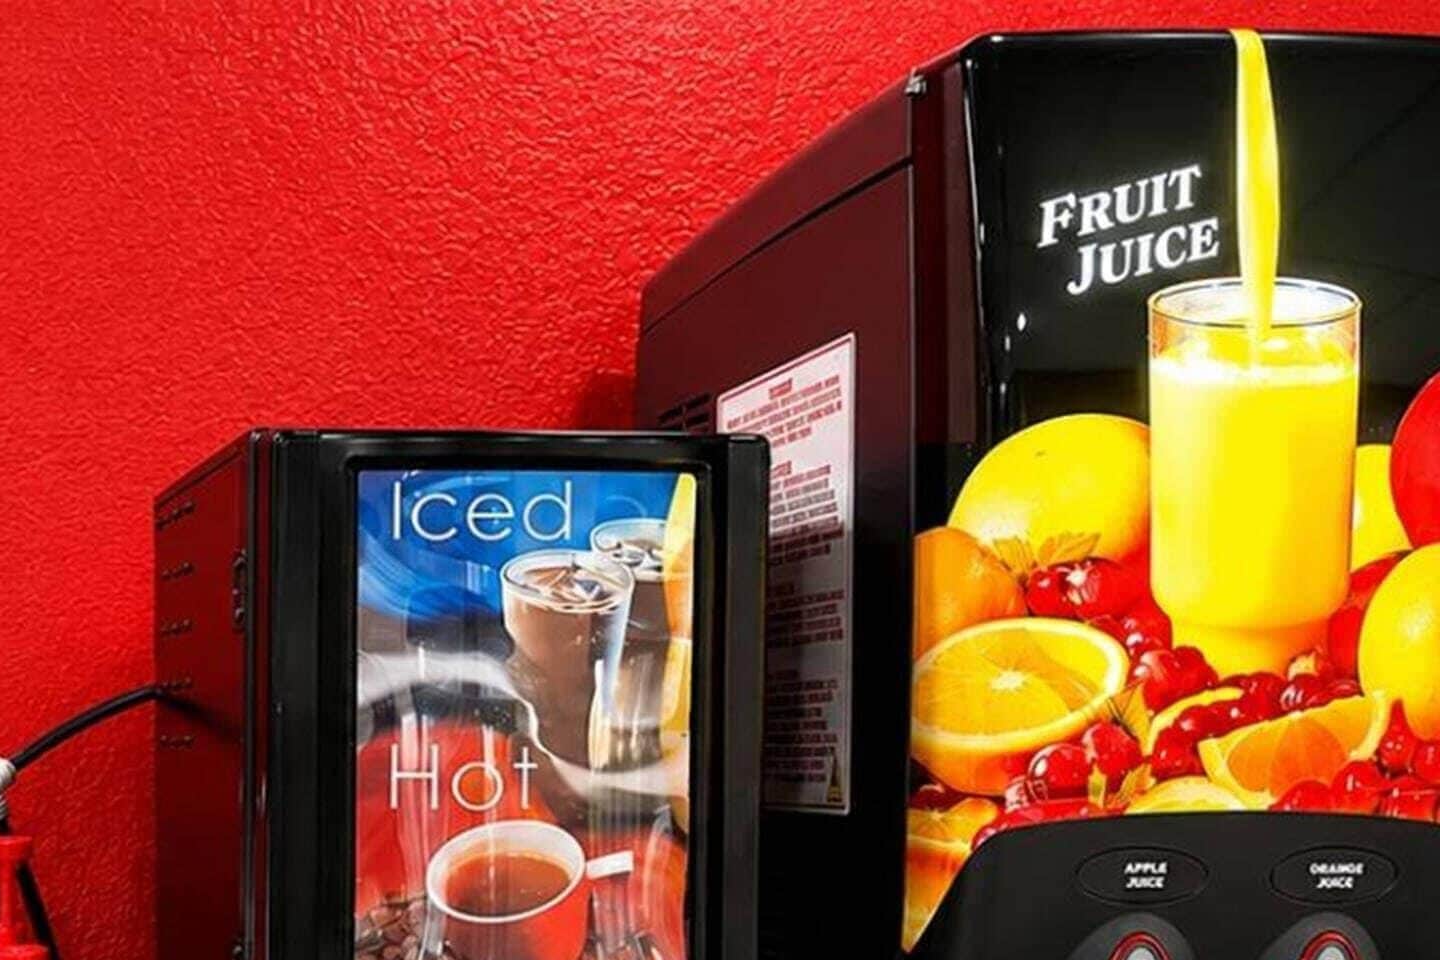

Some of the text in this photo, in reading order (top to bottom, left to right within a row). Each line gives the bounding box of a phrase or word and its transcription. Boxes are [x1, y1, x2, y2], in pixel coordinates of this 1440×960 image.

[1036, 164, 1202, 248] FRUIT
[1066, 217, 1220, 295] JUICE
[393, 480, 573, 541] Iced
[389, 743, 539, 812] Hot
[1124, 862, 1168, 875] APPLE
[1125, 876, 1165, 889] JUICE
[1310, 863, 1364, 875] ORANGE
[1316, 877, 1354, 889] JUICE
